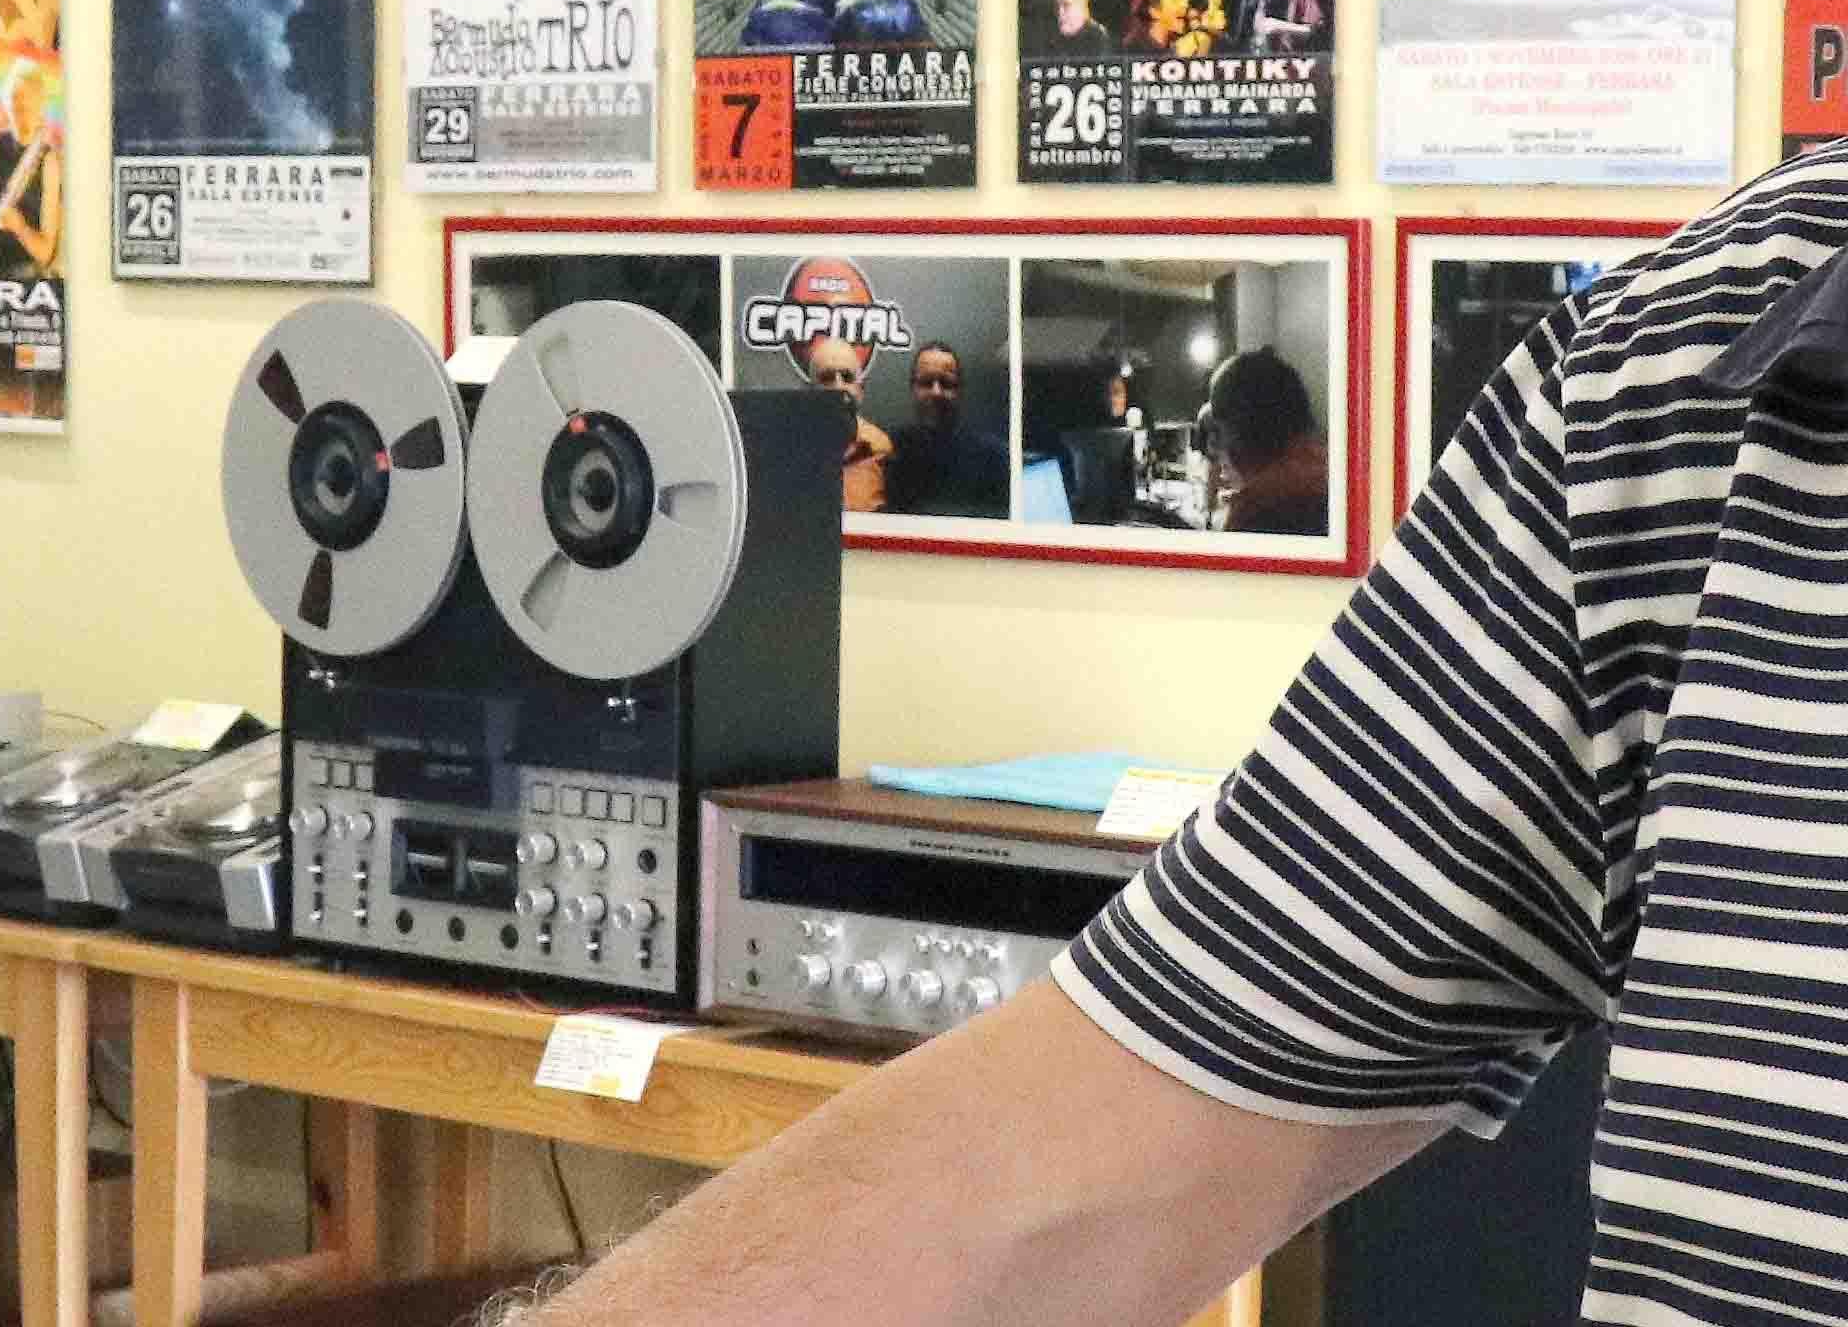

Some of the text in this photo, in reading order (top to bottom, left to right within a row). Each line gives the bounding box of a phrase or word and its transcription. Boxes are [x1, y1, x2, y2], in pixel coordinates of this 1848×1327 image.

[537, 0, 635, 73] TRIO
[794, 50, 971, 75] FERRARA
[1030, 64, 1123, 80] sabato
[1131, 59, 1316, 81] KONTIKY
[1131, 82, 1316, 100] VIGARANO MAINARDA
[1044, 82, 1106, 144] 26
[1131, 99, 1317, 115] FERRARA
[425, 107, 470, 144] 29
[722, 93, 760, 159] 7
[1030, 148, 1123, 165] settembre
[185, 165, 325, 185] FERRARA
[127, 192, 174, 239] 26
[749, 304, 911, 345] CAPITAL
